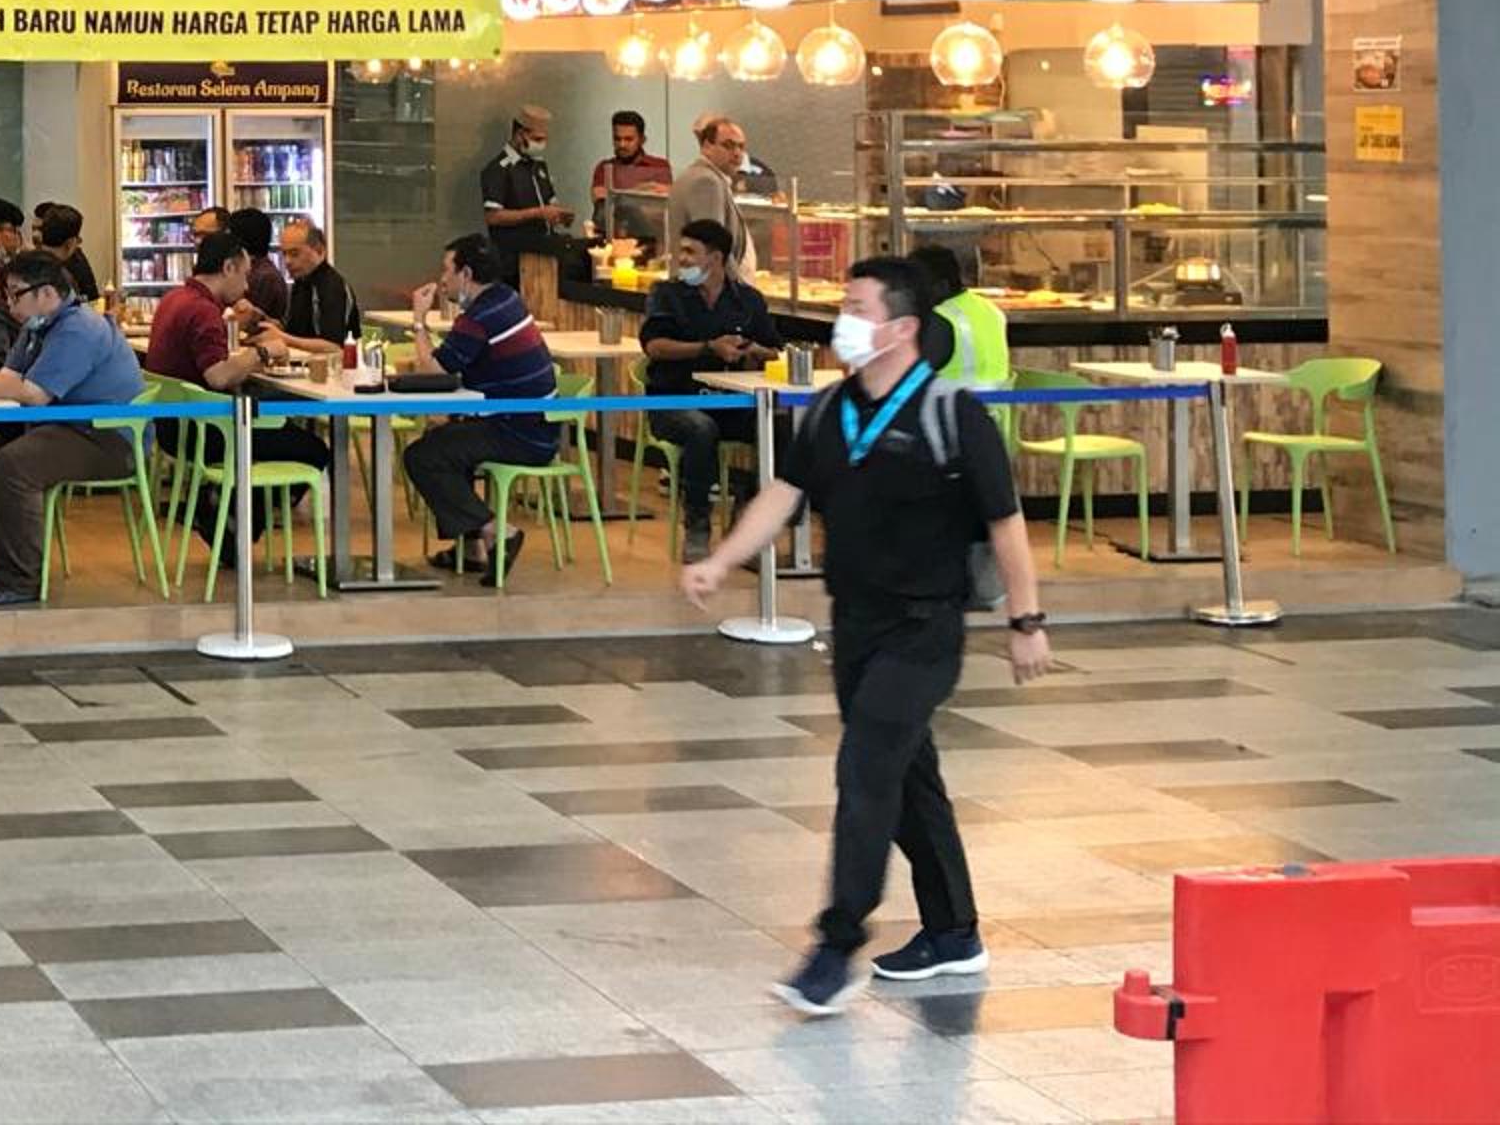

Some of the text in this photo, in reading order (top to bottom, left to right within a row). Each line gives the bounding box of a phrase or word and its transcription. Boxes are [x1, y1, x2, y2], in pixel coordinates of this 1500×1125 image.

[13, 9, 76, 34] BARU
[84, 9, 165, 35] NAMUN
[172, 10, 249, 36] HARGA
[256, 10, 320, 35] TETAP
[327, 9, 400, 35] HARGA
[408, 8, 466, 33] LAMA
[127, 79, 319, 101] Restoran Selera Ampang
